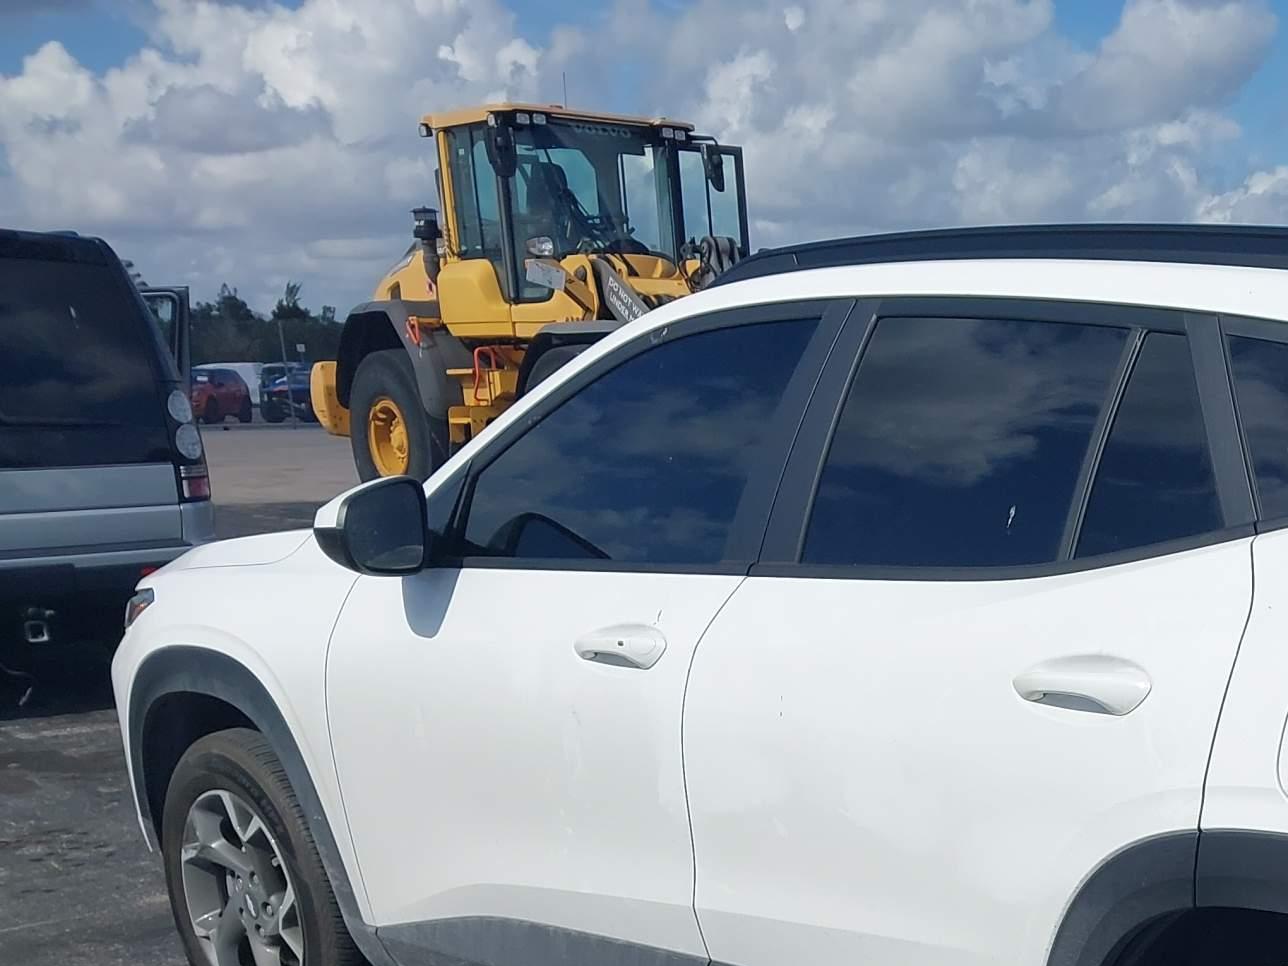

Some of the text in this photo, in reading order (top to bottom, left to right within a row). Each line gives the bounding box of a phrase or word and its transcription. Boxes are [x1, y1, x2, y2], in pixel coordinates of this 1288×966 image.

[574, 124, 632, 138] VOLVO
[608, 276, 619, 291] DO
[618, 286, 633, 306] NOT
[609, 291, 630, 321] UNDER
